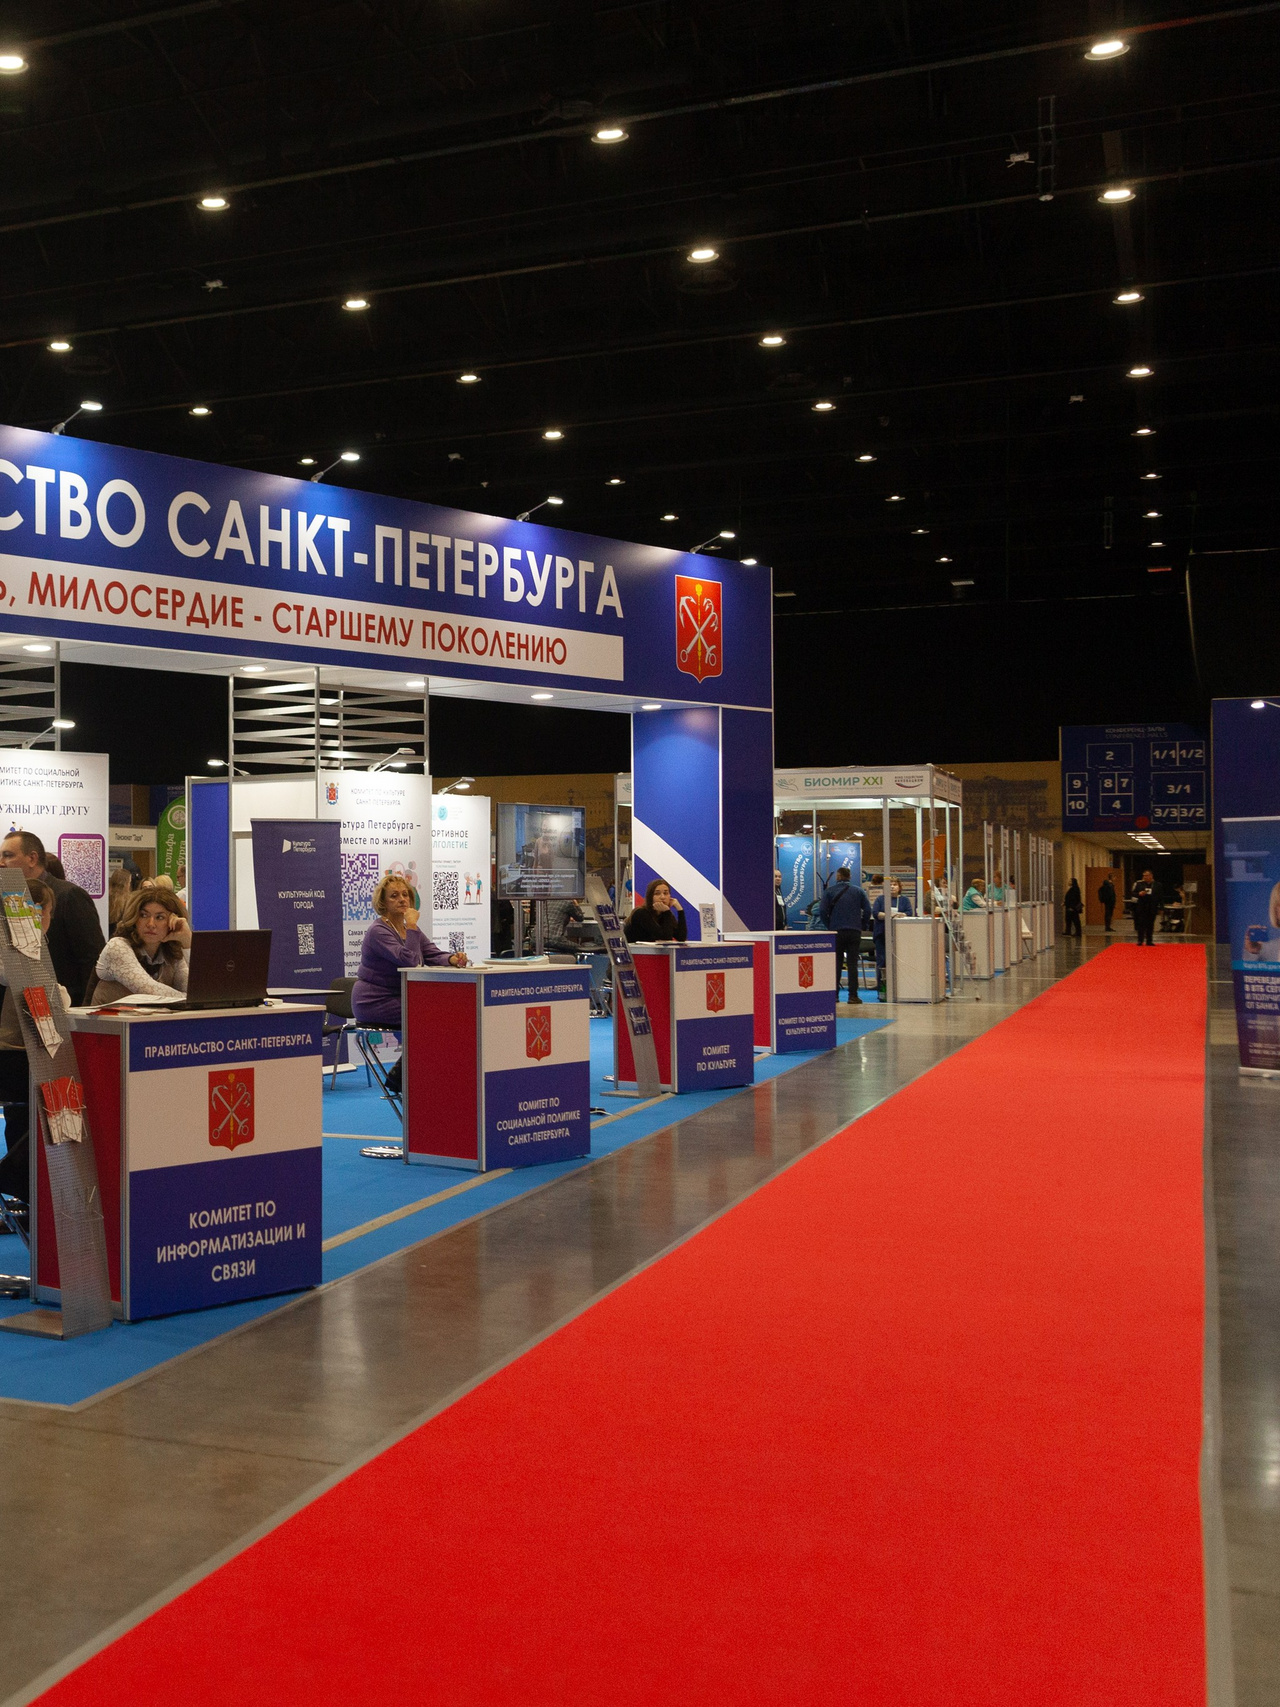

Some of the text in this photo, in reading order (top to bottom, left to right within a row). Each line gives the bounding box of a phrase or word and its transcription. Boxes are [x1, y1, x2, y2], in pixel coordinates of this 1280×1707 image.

[167, 490, 624, 619] САНКТ-ПЕТЕРБУРГА
[28, 571, 245, 629] МИЛОСЕРДИЕ
[273, 602, 415, 649] СТАРШЕМУ
[422, 620, 568, 666] ПОКОЛЕНИЮ
[1105, 751, 1115, 761] 2
[1152, 749, 1204, 760] 1/1 1/2
[23, 767, 33, 775] ПО
[34, 767, 80, 778] СОЦИАЛЬНОЙ
[22, 779, 84, 789] САНКТ-ПЕТЕРБУРГА
[804, 776, 860, 787] БИОМИР
[1072, 779, 1082, 789] 9
[1103, 778, 1130, 788] 8 7
[1166, 784, 1192, 794] 3/1
[32, 804, 58, 815] ДРУГ
[59, 805, 91, 816] ДРУГУ
[1068, 800, 1086, 810] 10
[1111, 800, 1121, 810] 4
[1153, 807, 1205, 818] 3/3 3/2
[367, 820, 414, 831] Петербурга
[382, 836, 412, 846] жизни!
[278, 889, 326, 899] КУЛЬТУРНЫЙ КОД
[293, 901, 315, 909] ГОРОДА
[490, 984, 584, 998] ПРАВИТЕЛЬСТВО САНКТ-ПЕТЕРБУРГА
[144, 1033, 312, 1058] ПРАВИТЕЛЬСТВО САНКТ-ПЕТЕРБУРГА
[702, 1044, 731, 1056] КОМИТЕТ
[696, 1058, 737, 1072] ПО КУЛЬТУРЕ
[518, 1097, 560, 1112] КОМИТЕТ ПО
[496, 1110, 581, 1131] СОЦИАЛЬНОЙ ПОЛИТИКЕ
[507, 1127, 570, 1146] САНКТ-ПЕТЕРБУРГА
[189, 1200, 277, 1229] КОМИТЕТ ПО
[156, 1222, 306, 1264] ИНФОРМАТИЗАЦИИ И
[211, 1259, 256, 1282] СВЯЗИ
